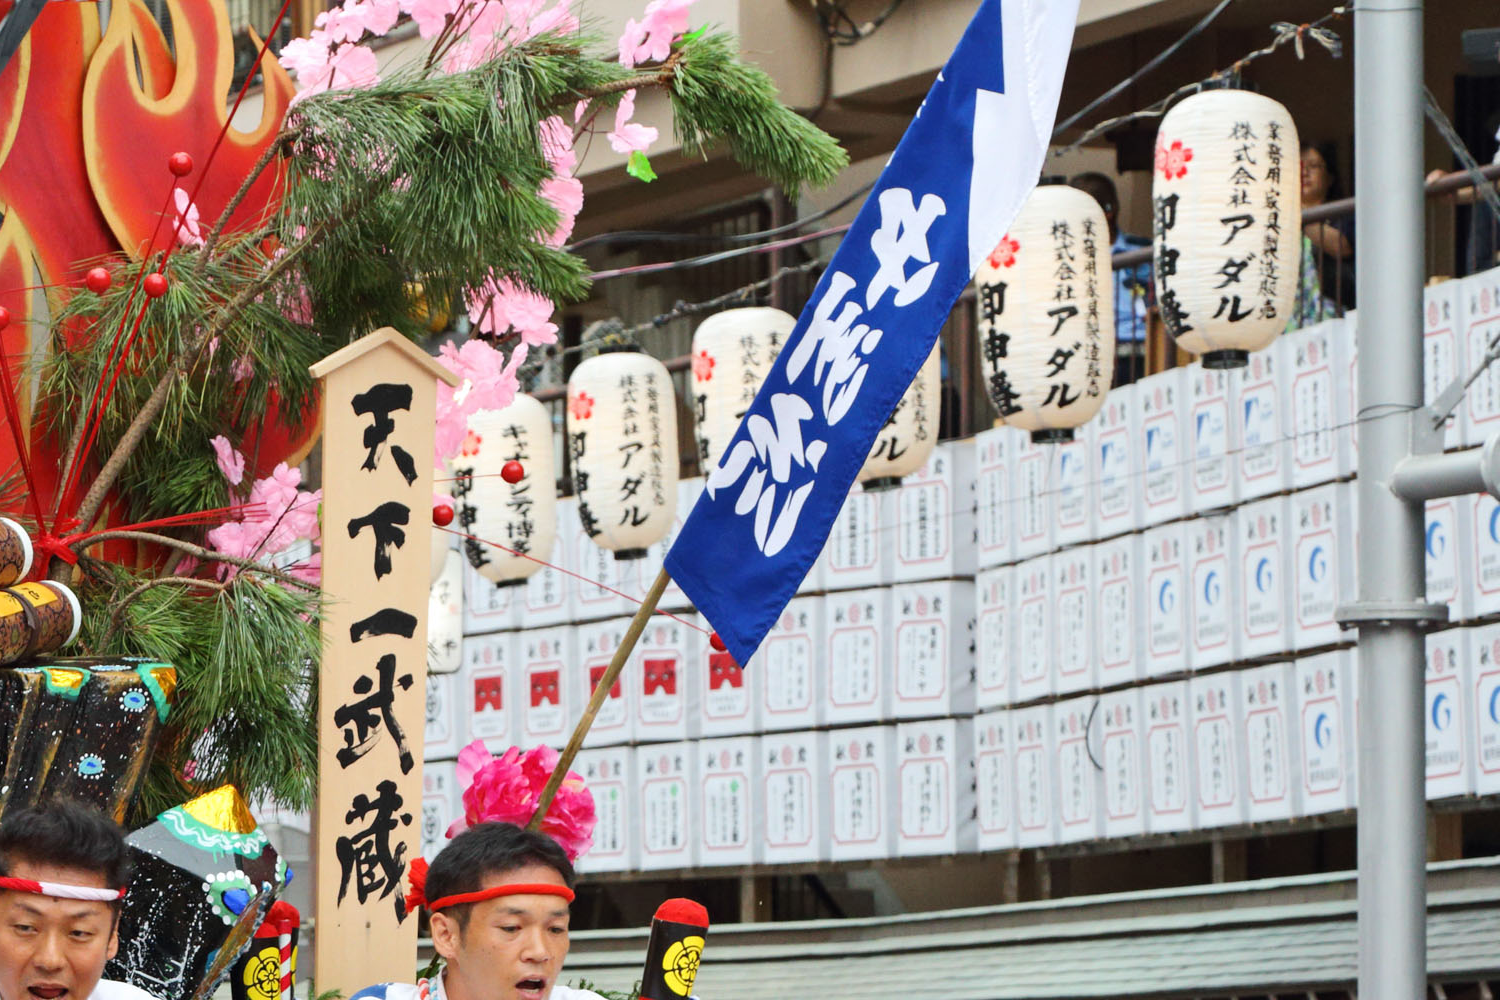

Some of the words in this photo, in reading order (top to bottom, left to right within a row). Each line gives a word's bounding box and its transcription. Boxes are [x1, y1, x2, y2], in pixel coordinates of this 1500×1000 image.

[334, 381, 419, 925] 天下一武蔵
